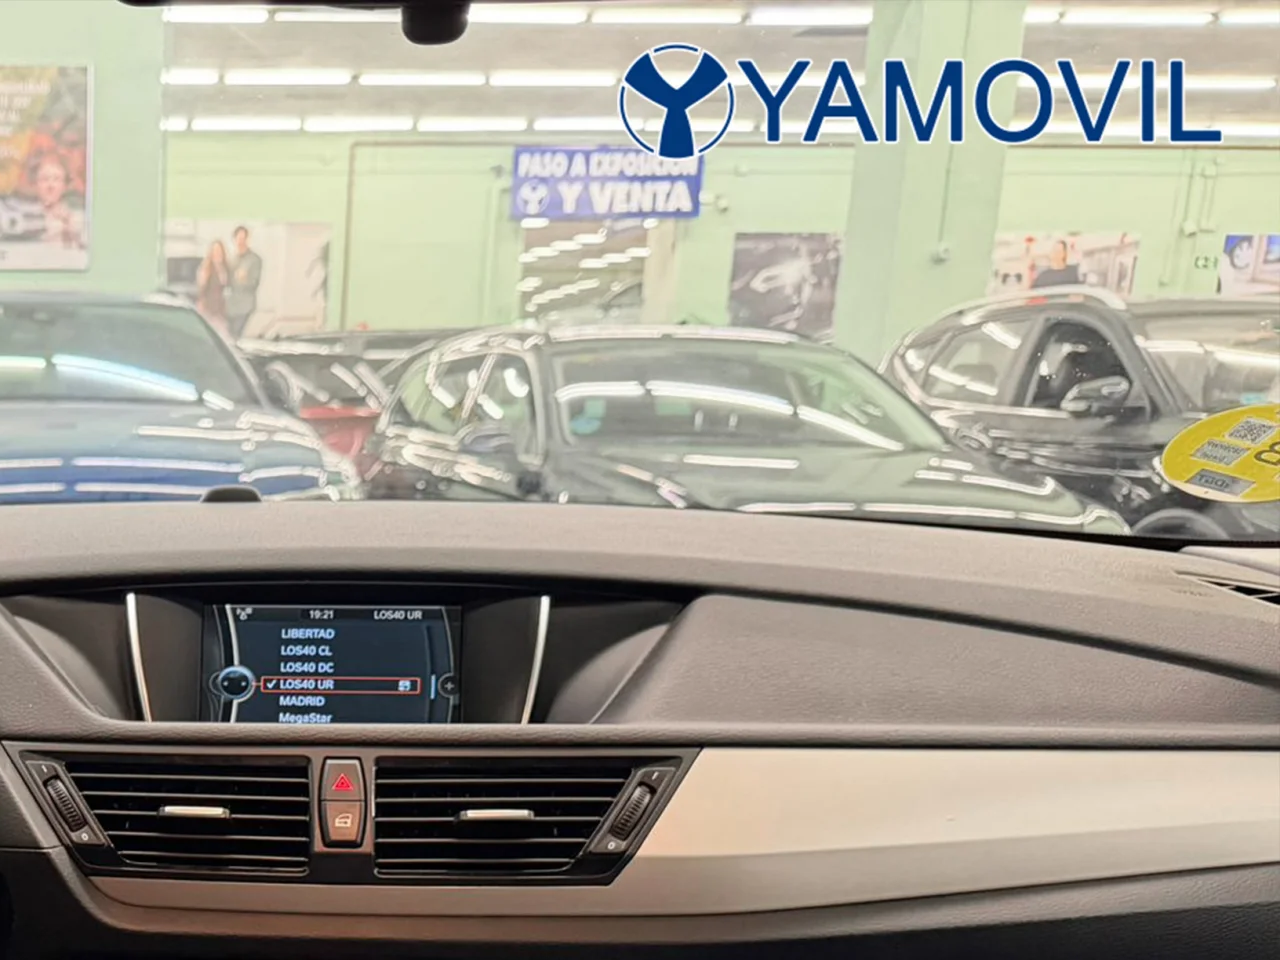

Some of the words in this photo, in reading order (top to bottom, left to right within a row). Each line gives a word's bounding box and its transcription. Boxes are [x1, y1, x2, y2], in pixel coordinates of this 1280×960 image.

[571, 152, 587, 177] A
[557, 181, 583, 213] Y
[589, 181, 692, 214] VENTA
[309, 610, 335, 619] 19:21
[374, 610, 404, 620] LOS40
[407, 611, 423, 620] UR
[281, 628, 335, 639] LIBERTAD
[280, 646, 316, 656] LOS40
[318, 646, 333, 656] CL
[280, 662, 316, 673] LOS40
[318, 663, 335, 673] DC
[280, 679, 316, 690] LOS40
[317, 680, 335, 690] UR
[279, 696, 325, 707] MADRID
[279, 713, 332, 723] MegaStar
